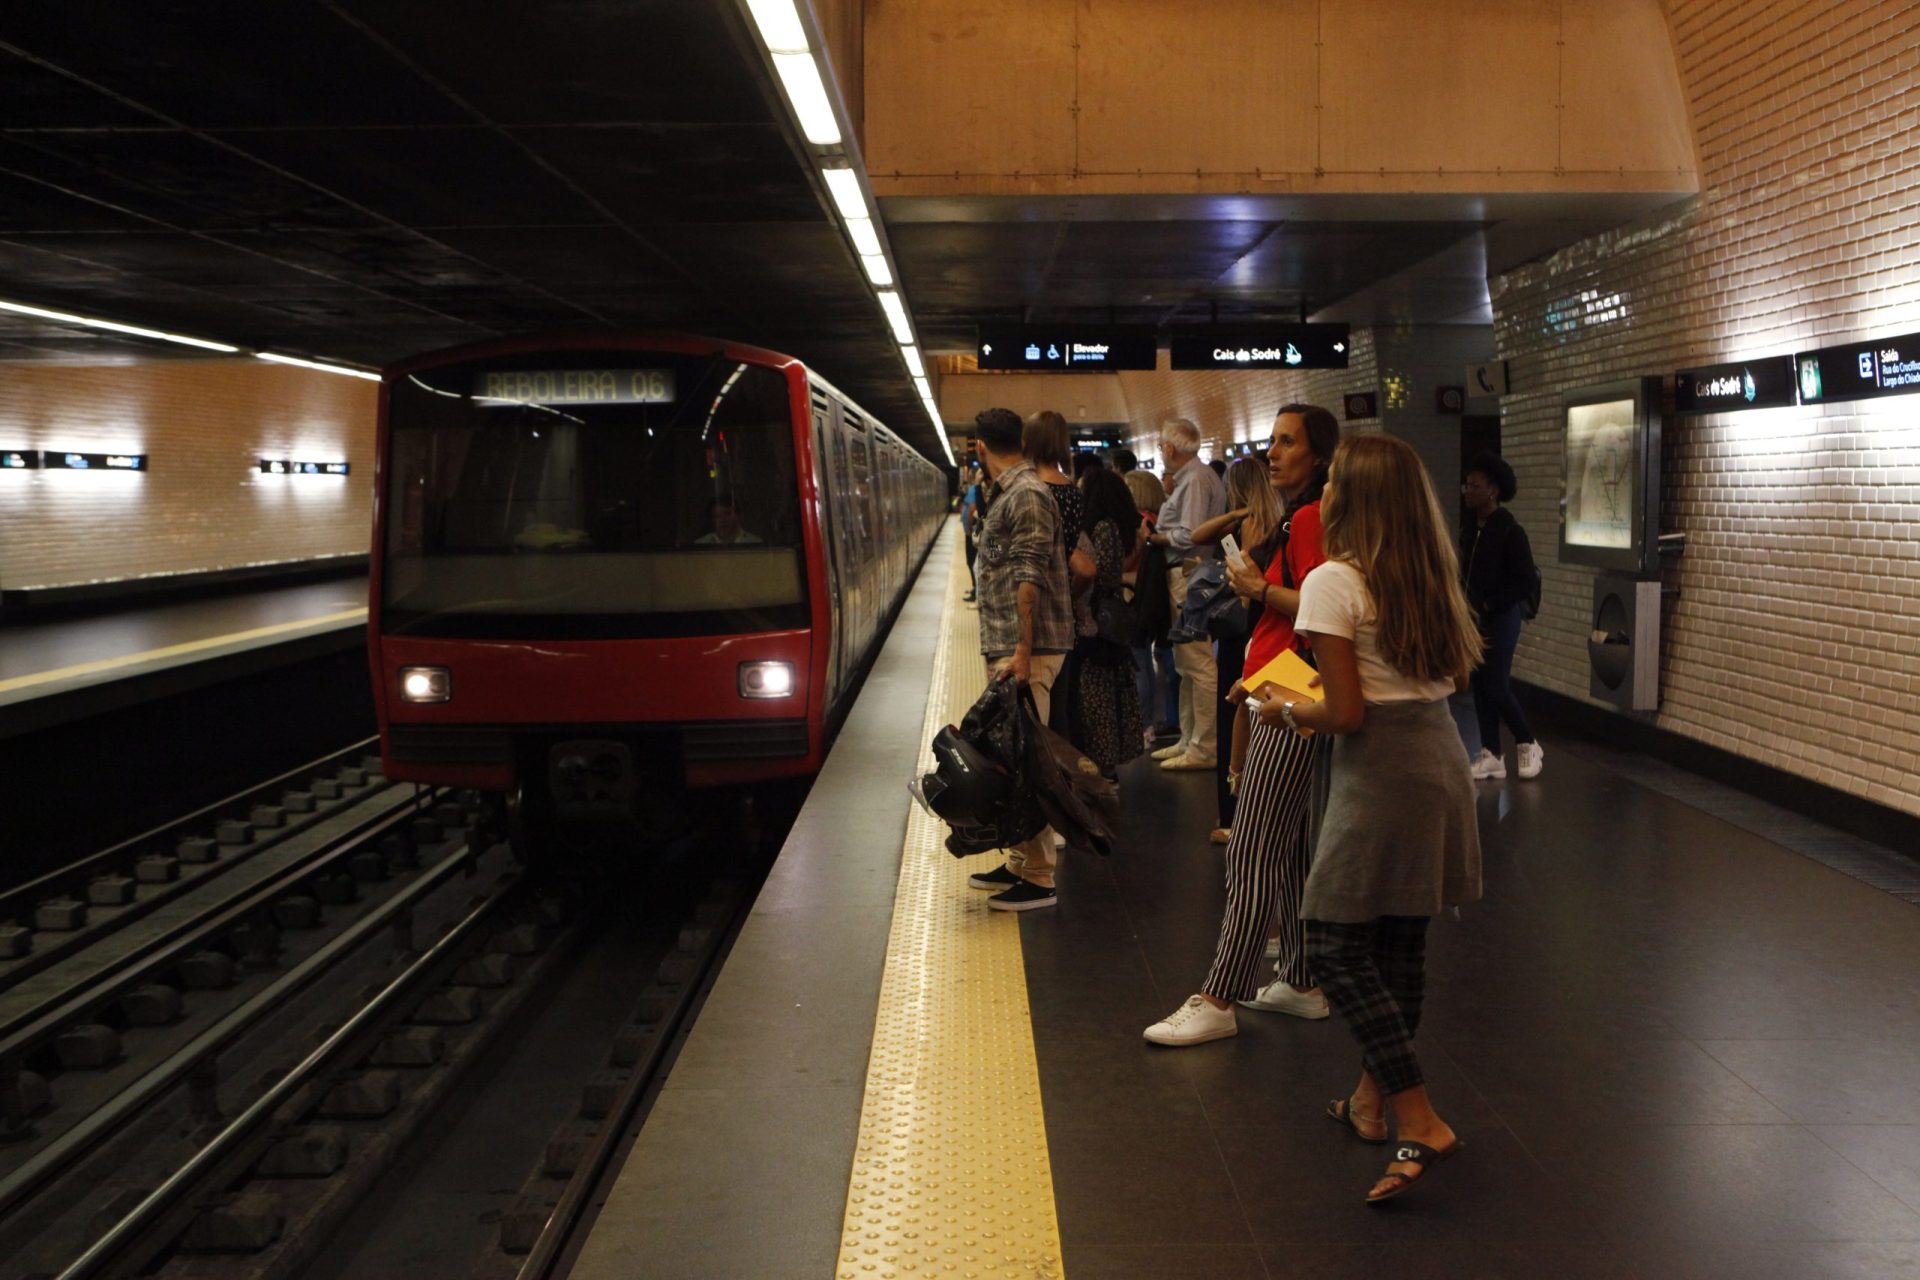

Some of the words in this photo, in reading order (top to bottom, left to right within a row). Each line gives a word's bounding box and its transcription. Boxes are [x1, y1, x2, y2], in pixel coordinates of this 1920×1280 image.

[1213, 348, 1235, 360] Cais
[1251, 347, 1281, 360] Sodré
[1882, 365, 1892, 375] Rua
[486, 371, 617, 401] REBOLEIRA
[631, 372, 665, 399] 06
[1883, 376, 1897, 388] Largo
[1696, 381, 1710, 397] Cais
